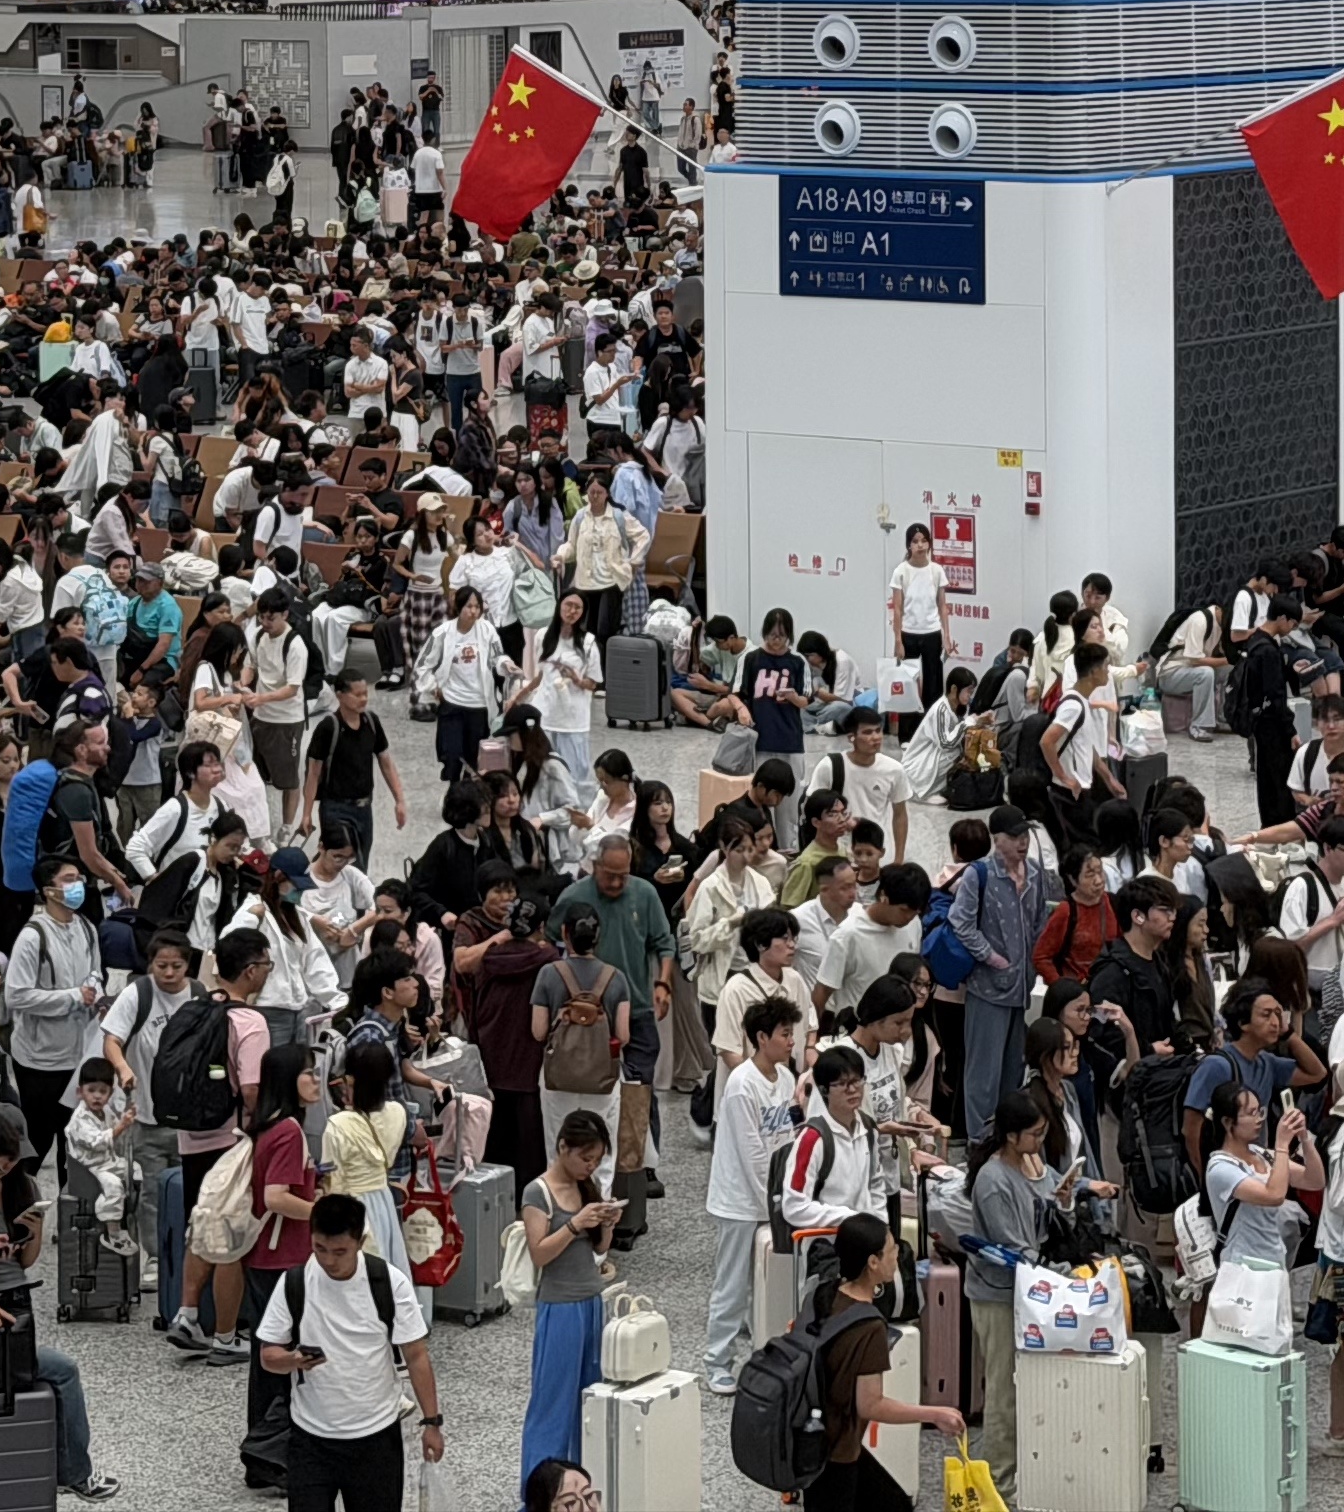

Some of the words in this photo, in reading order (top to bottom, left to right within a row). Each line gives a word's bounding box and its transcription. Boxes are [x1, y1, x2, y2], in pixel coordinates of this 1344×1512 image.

[860, 231, 890, 256] A1
[858, 271, 865, 291] 1
[754, 668, 791, 698] Hi
